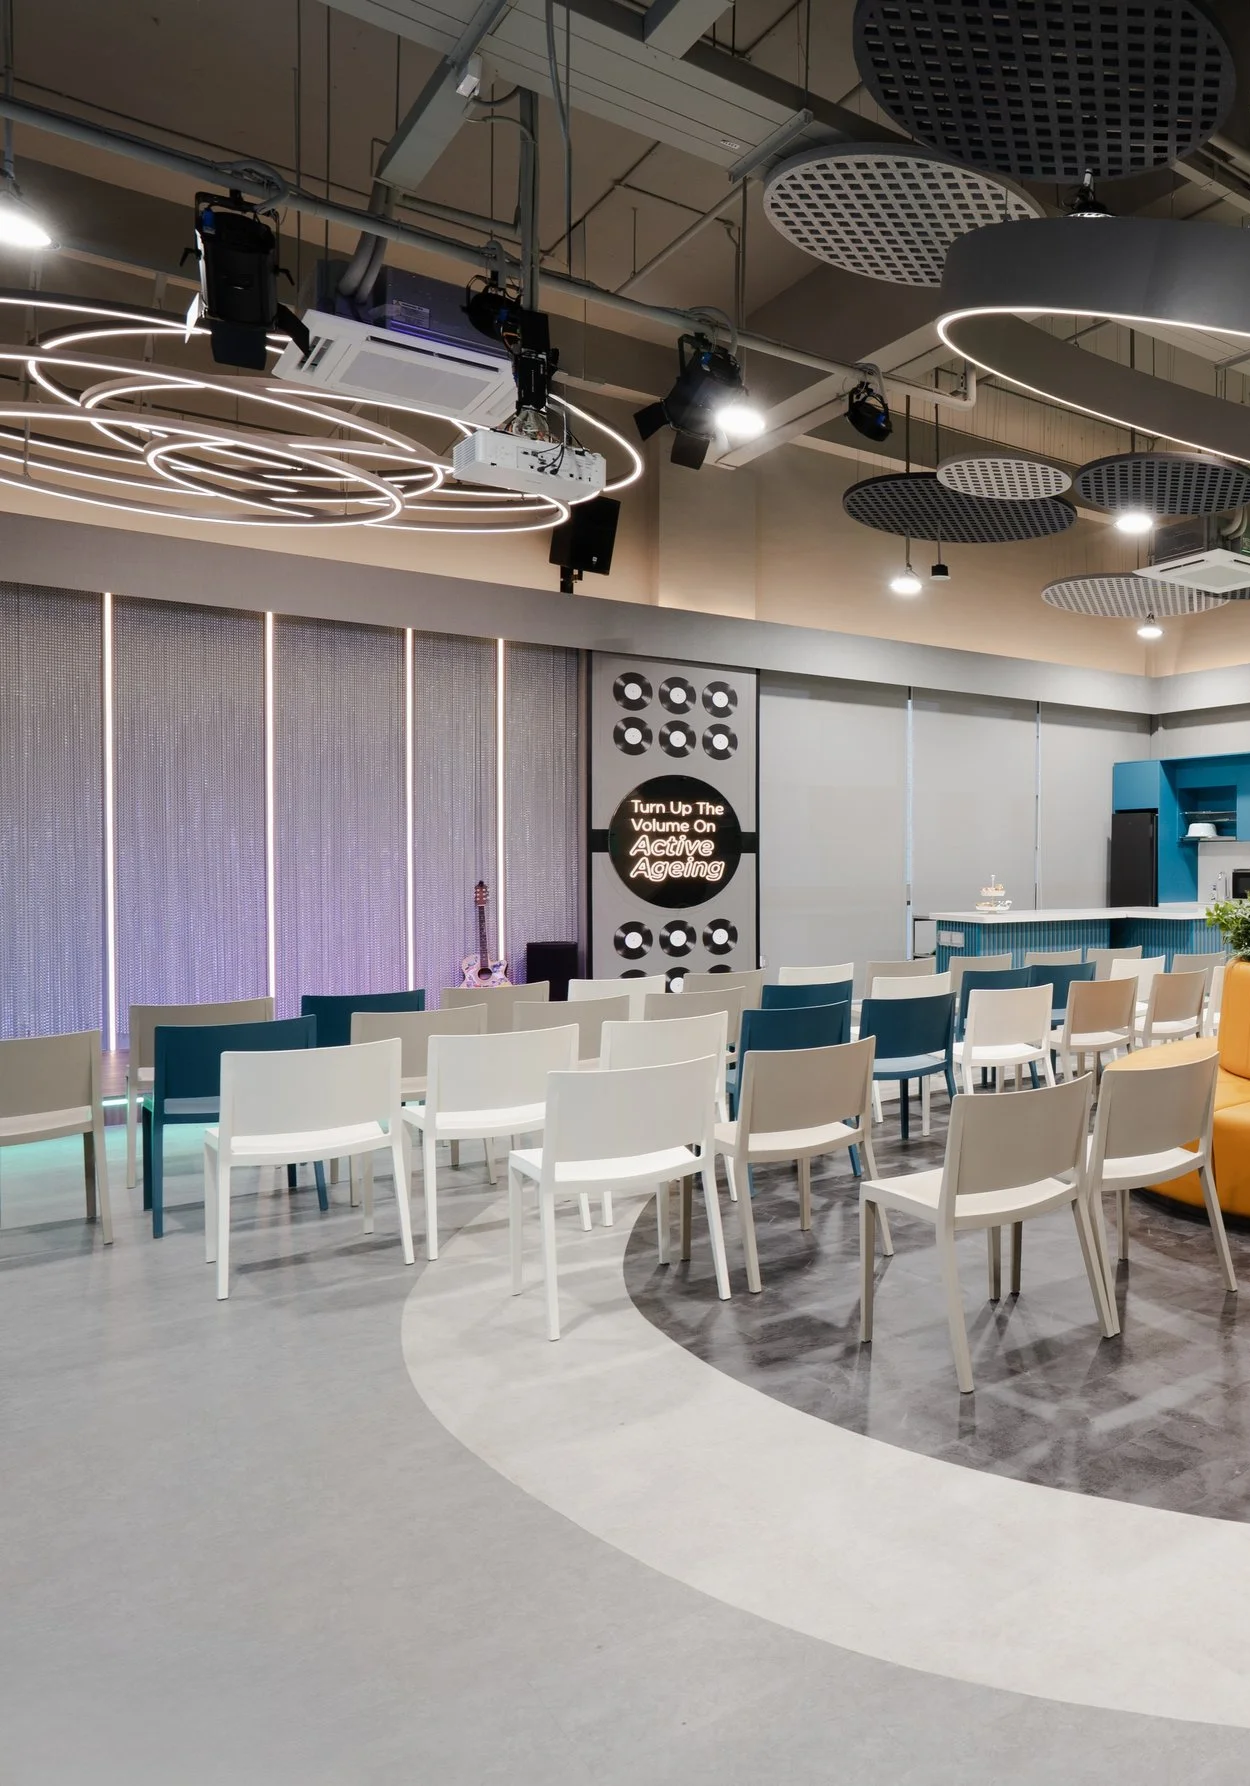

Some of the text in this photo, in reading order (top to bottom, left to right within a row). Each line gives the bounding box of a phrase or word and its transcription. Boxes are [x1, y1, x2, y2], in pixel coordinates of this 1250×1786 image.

[630, 799, 725, 816] Turn Up The
[631, 818, 716, 833] Volume On
[629, 834, 715, 857] Active
[629, 857, 725, 882] Ageing
